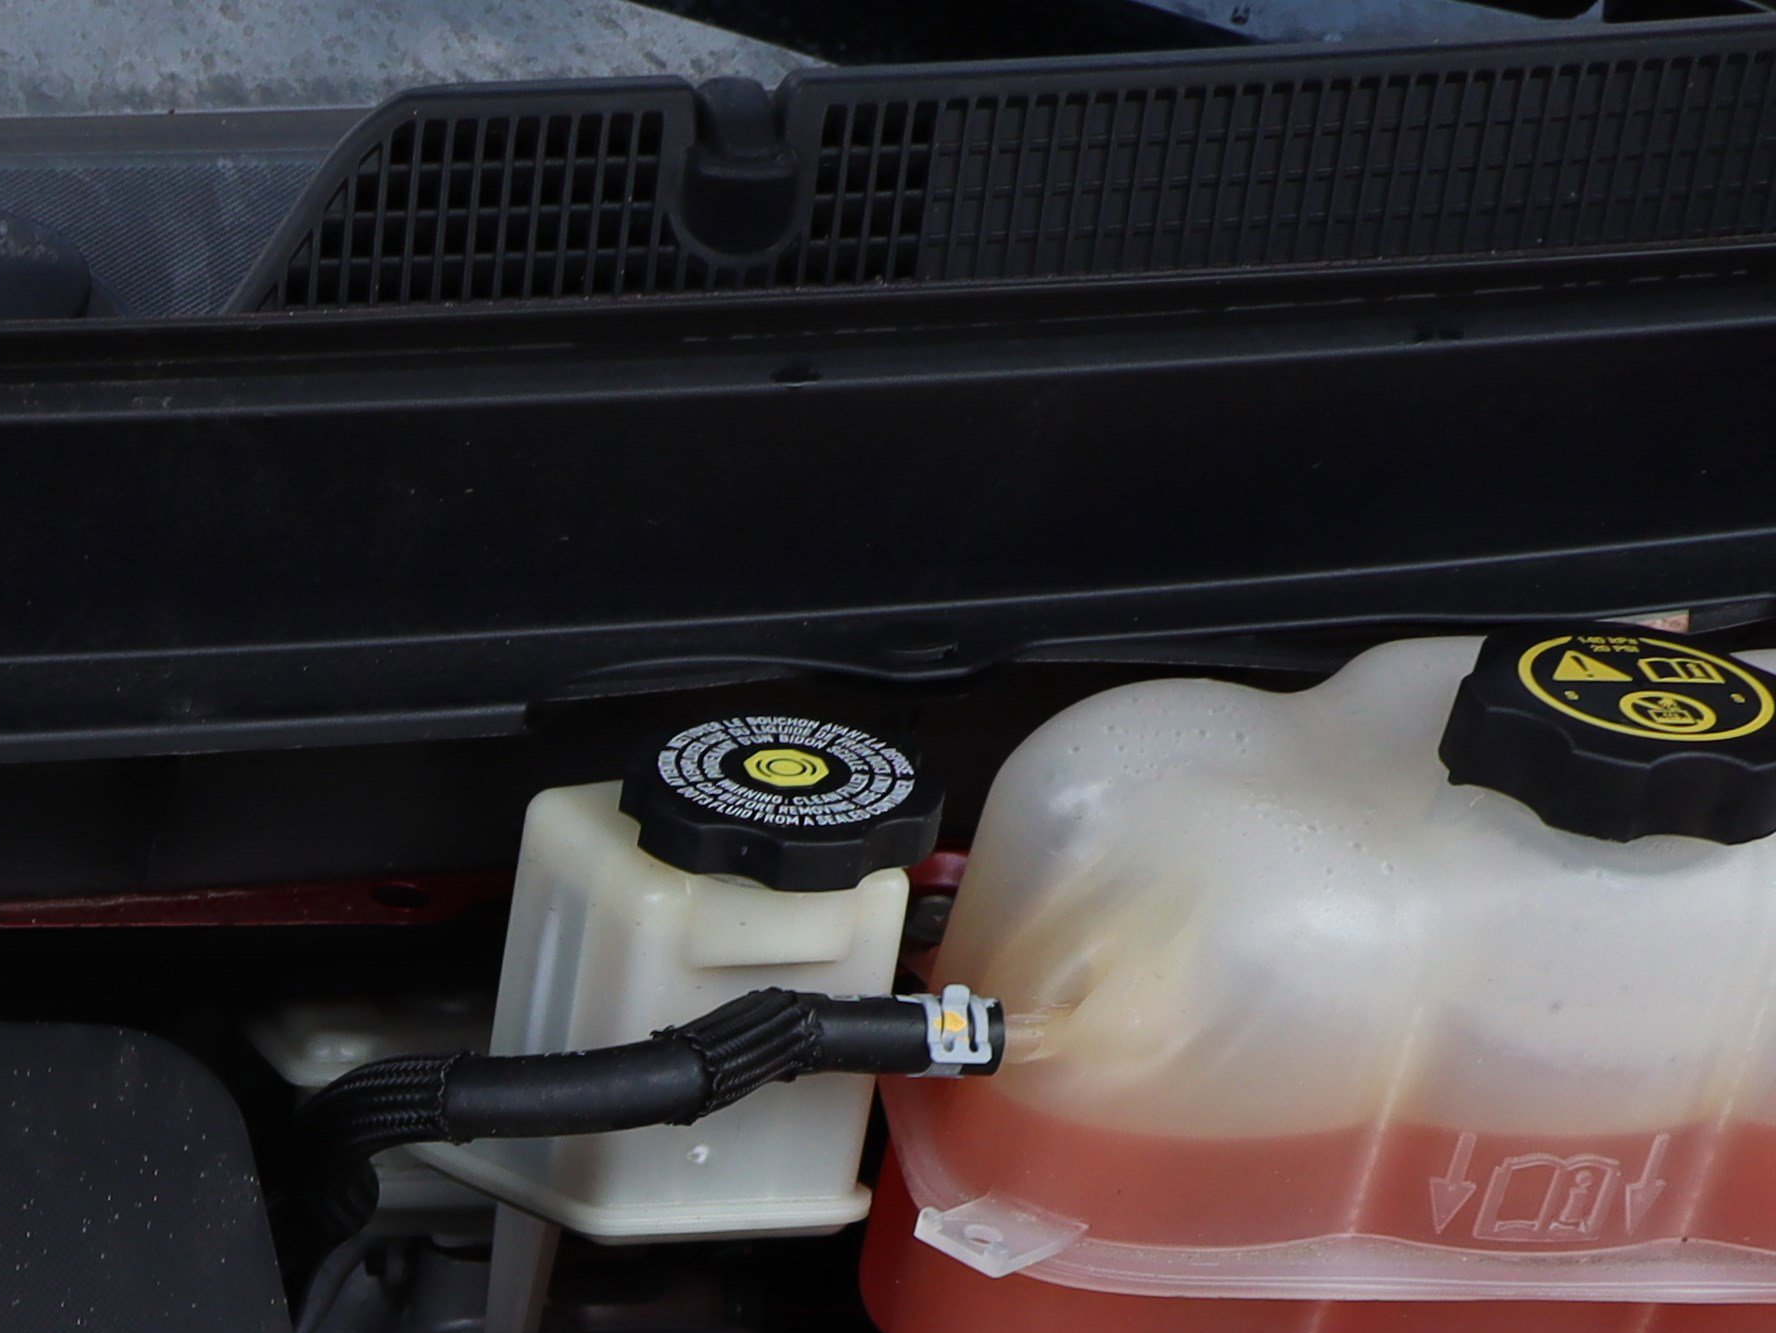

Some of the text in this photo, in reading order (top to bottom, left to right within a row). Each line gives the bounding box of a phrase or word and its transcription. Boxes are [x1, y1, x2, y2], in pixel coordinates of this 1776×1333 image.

[745, 717, 821, 729] BOUCHON
[819, 723, 870, 742] AVANT
[778, 733, 830, 749] BIDON
[695, 782, 724, 797] CAP
[717, 793, 776, 814] BEFORE
[707, 801, 754, 818] FLUID
[753, 811, 800, 825] FROM
[803, 816, 815, 826] A
